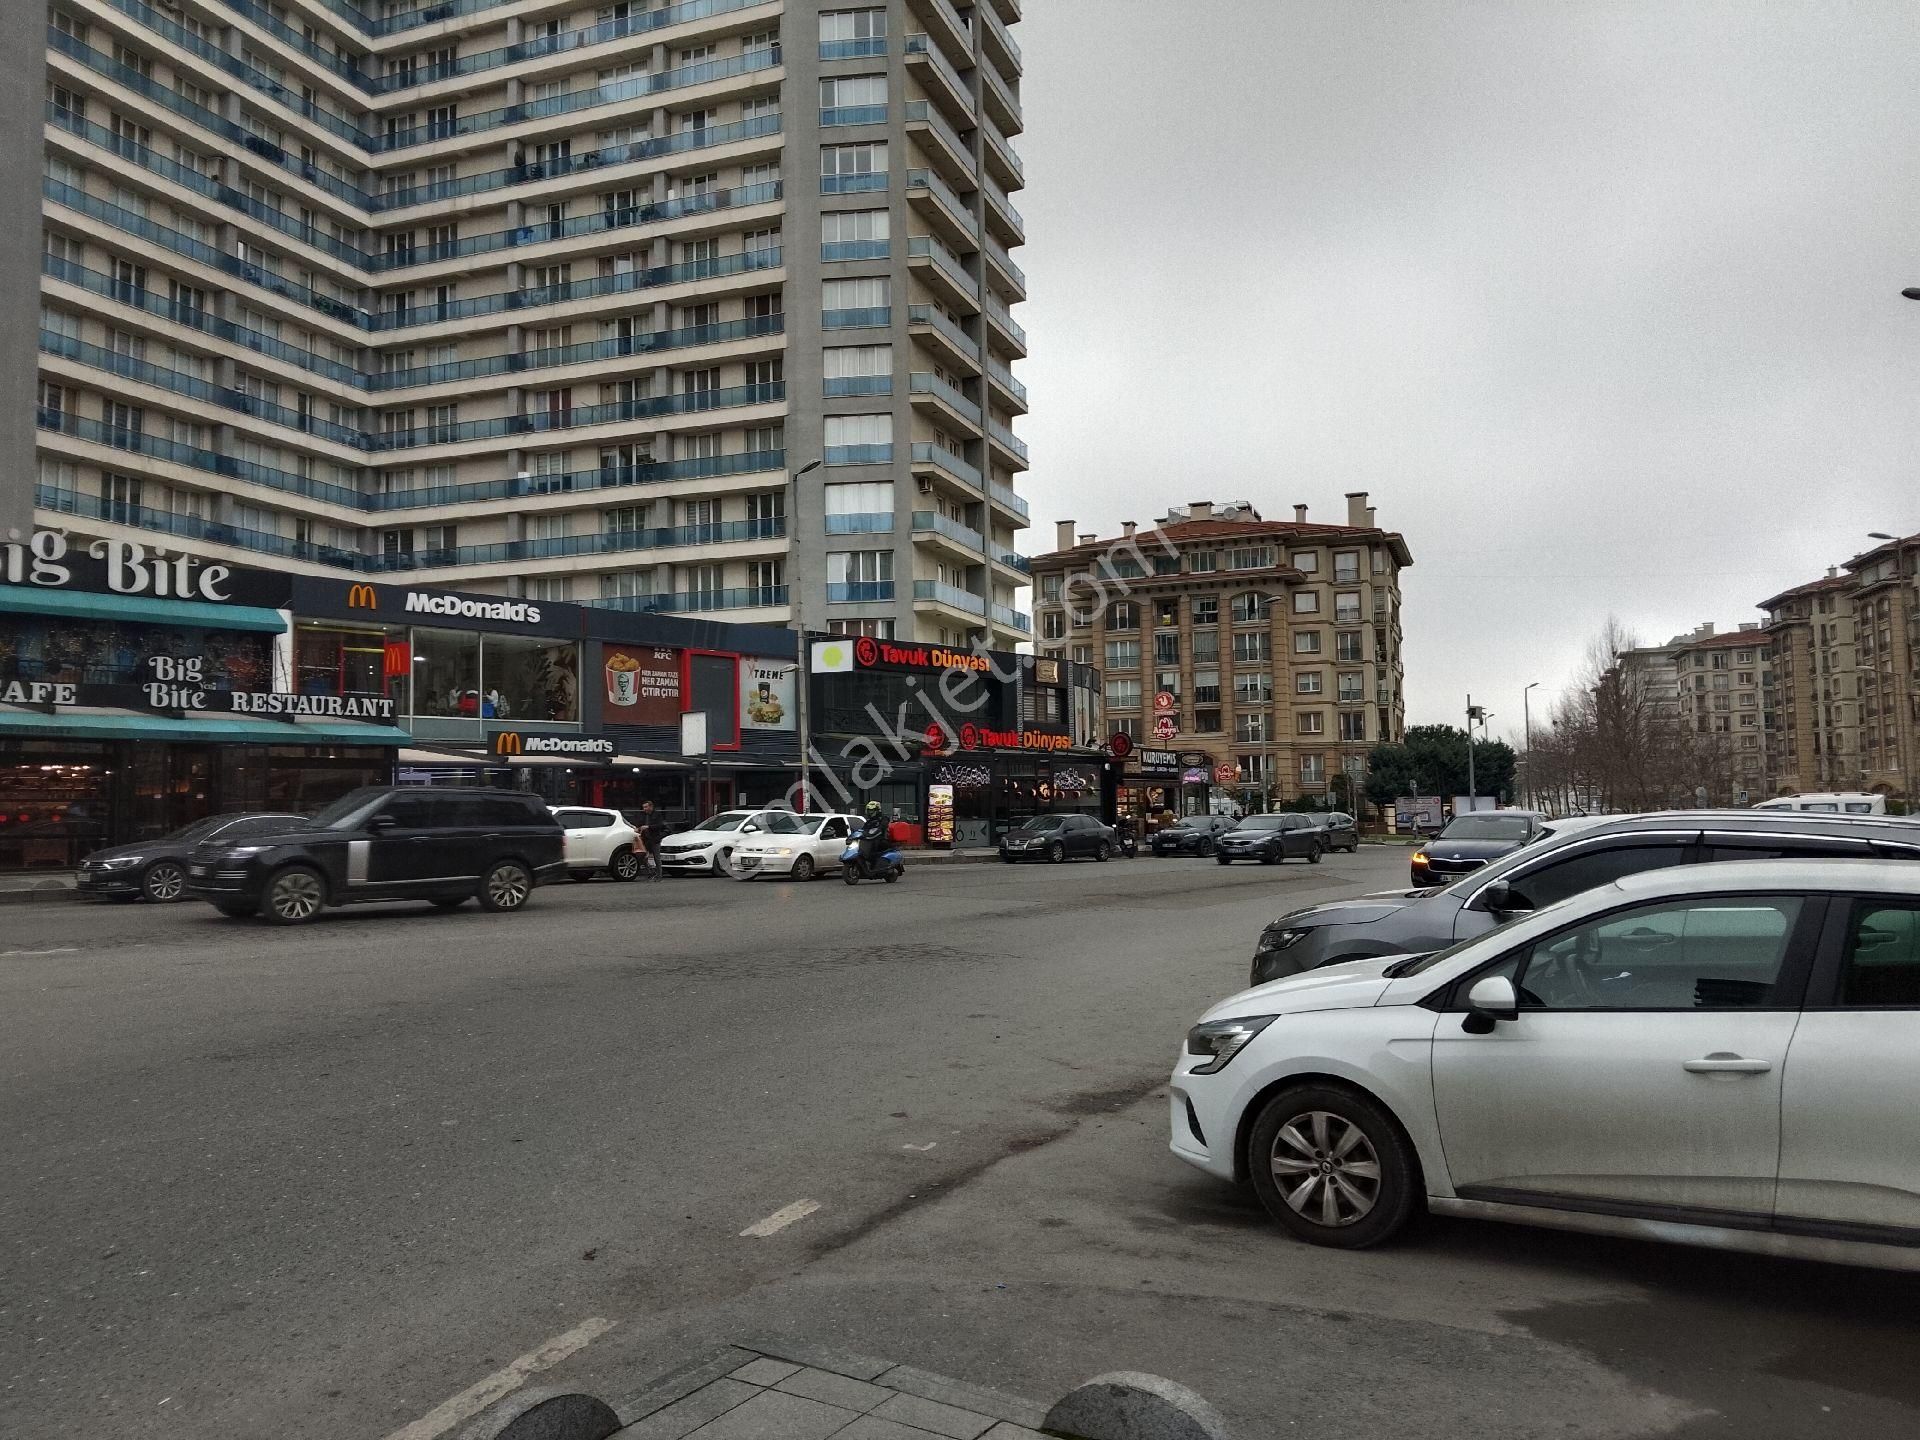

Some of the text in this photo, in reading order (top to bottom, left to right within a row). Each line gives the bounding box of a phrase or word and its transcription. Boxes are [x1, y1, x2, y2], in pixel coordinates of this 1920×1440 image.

[0, 528, 232, 601] ig Bite
[404, 592, 541, 623] McDonald's
[148, 655, 204, 683] Big
[653, 651, 672, 660] KFC
[880, 644, 990, 673] Tavuk Dünyası
[0, 680, 76, 705] AFE
[142, 682, 207, 709] Bite
[642, 677, 678, 687] HER ZAMAN
[230, 691, 394, 719] RESTAURANT
[525, 737, 613, 753] McDonald's
[979, 728, 1072, 752] Tavuk Dünyası
